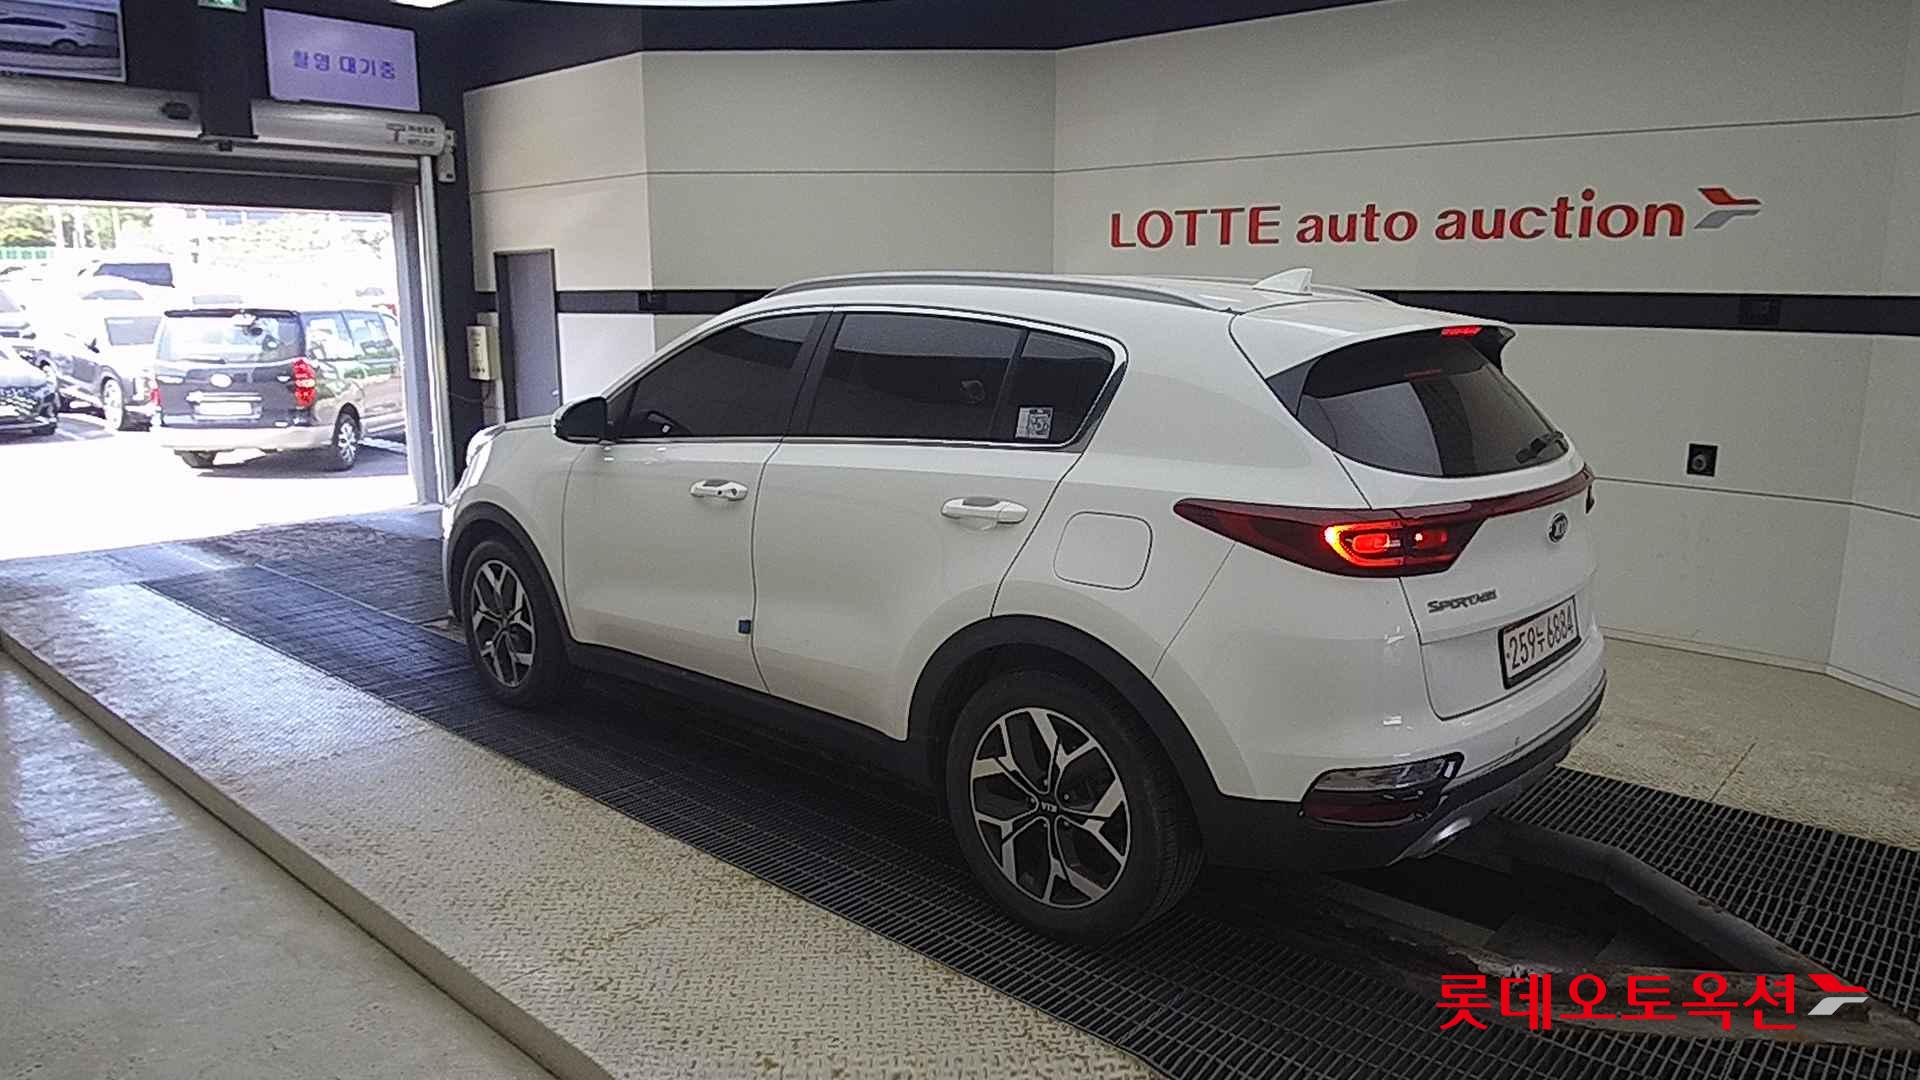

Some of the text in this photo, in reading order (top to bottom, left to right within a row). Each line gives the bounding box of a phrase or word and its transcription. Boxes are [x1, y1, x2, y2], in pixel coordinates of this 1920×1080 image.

[340, 55, 396, 80] 대기중
[1110, 188, 1685, 248] LOTTE auto auction
